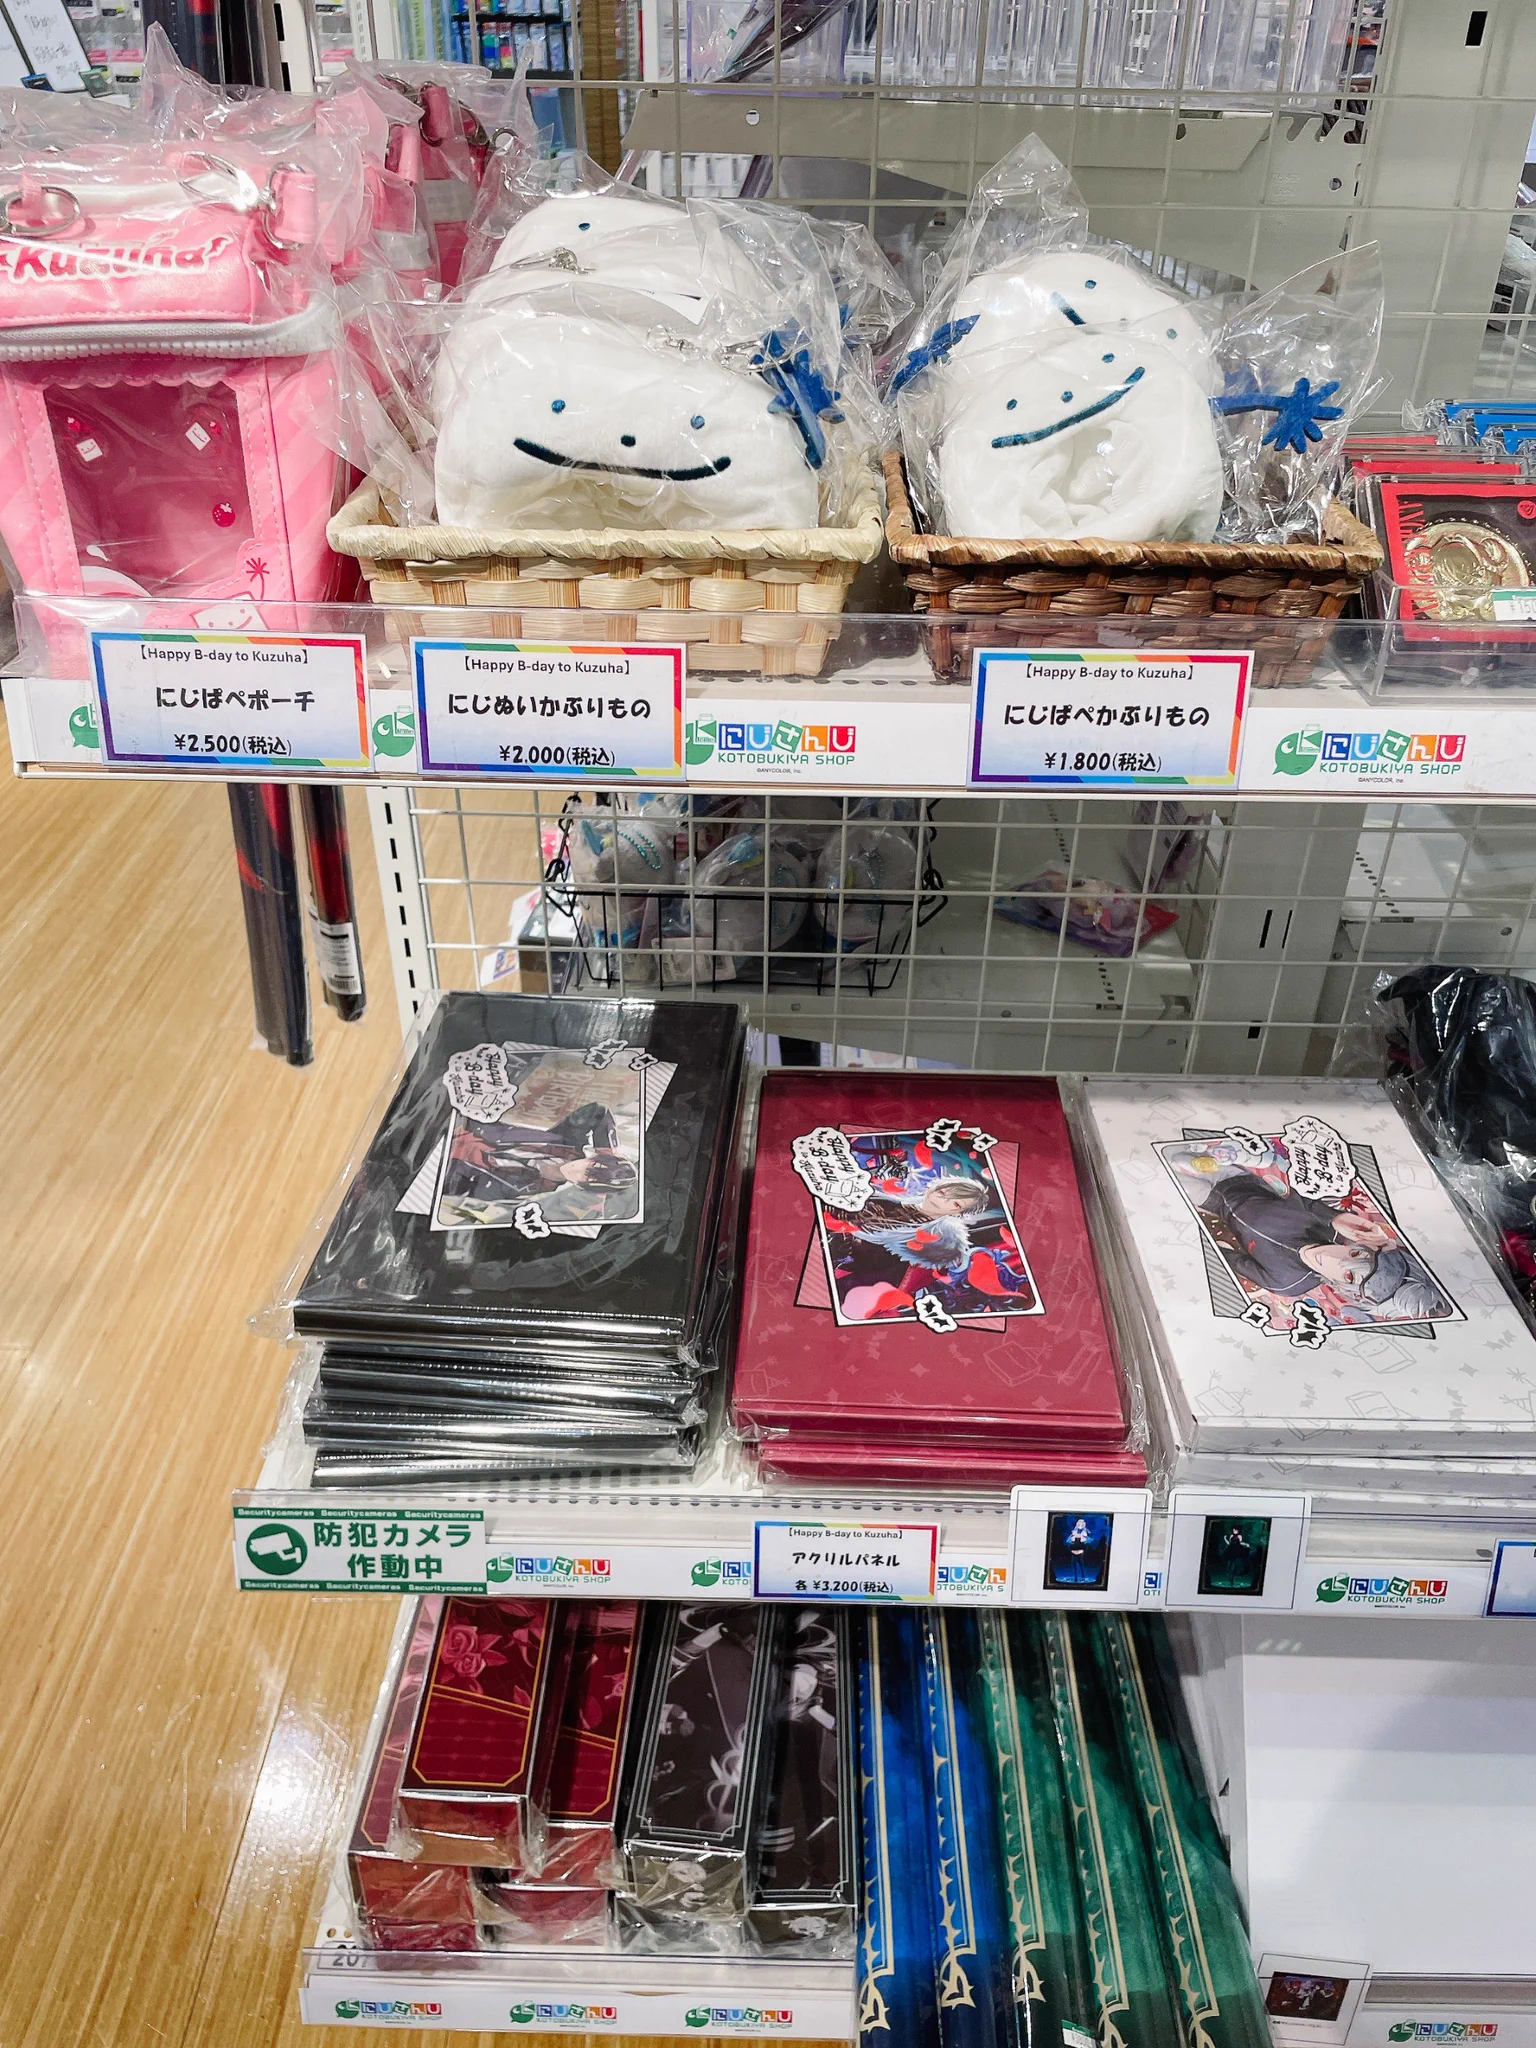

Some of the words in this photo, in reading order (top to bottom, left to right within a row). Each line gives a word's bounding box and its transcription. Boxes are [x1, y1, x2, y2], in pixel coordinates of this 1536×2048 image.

[195, 648, 232, 662] B-day
[236, 650, 249, 661] to
[518, 660, 555, 674] B-day
[558, 662, 571, 672] to
[1080, 667, 1117, 680] B-day
[1121, 668, 1133, 679] to
[156, 687, 315, 712] にじぱぺポーチ
[448, 694, 651, 719] にじぬいかぶりもの
[1004, 704, 1210, 727] にじぱぺかぶりもの
[718, 753, 809, 765] KOTOBUKIYA
[815, 755, 855, 765] SHOP
[1320, 762, 1413, 775] KOTOBUKIYA
[1420, 764, 1461, 775] SHOP
[827, 1135, 855, 1174] Happy
[809, 1147, 839, 1183] B-day
[313, 1522, 472, 1548] 防犯カメラ
[825, 1530, 850, 1539] B-day
[347, 1553, 443, 1579] 作動中
[792, 1552, 901, 1567] アクリルパネル
[795, 1580, 807, 1591] 各
